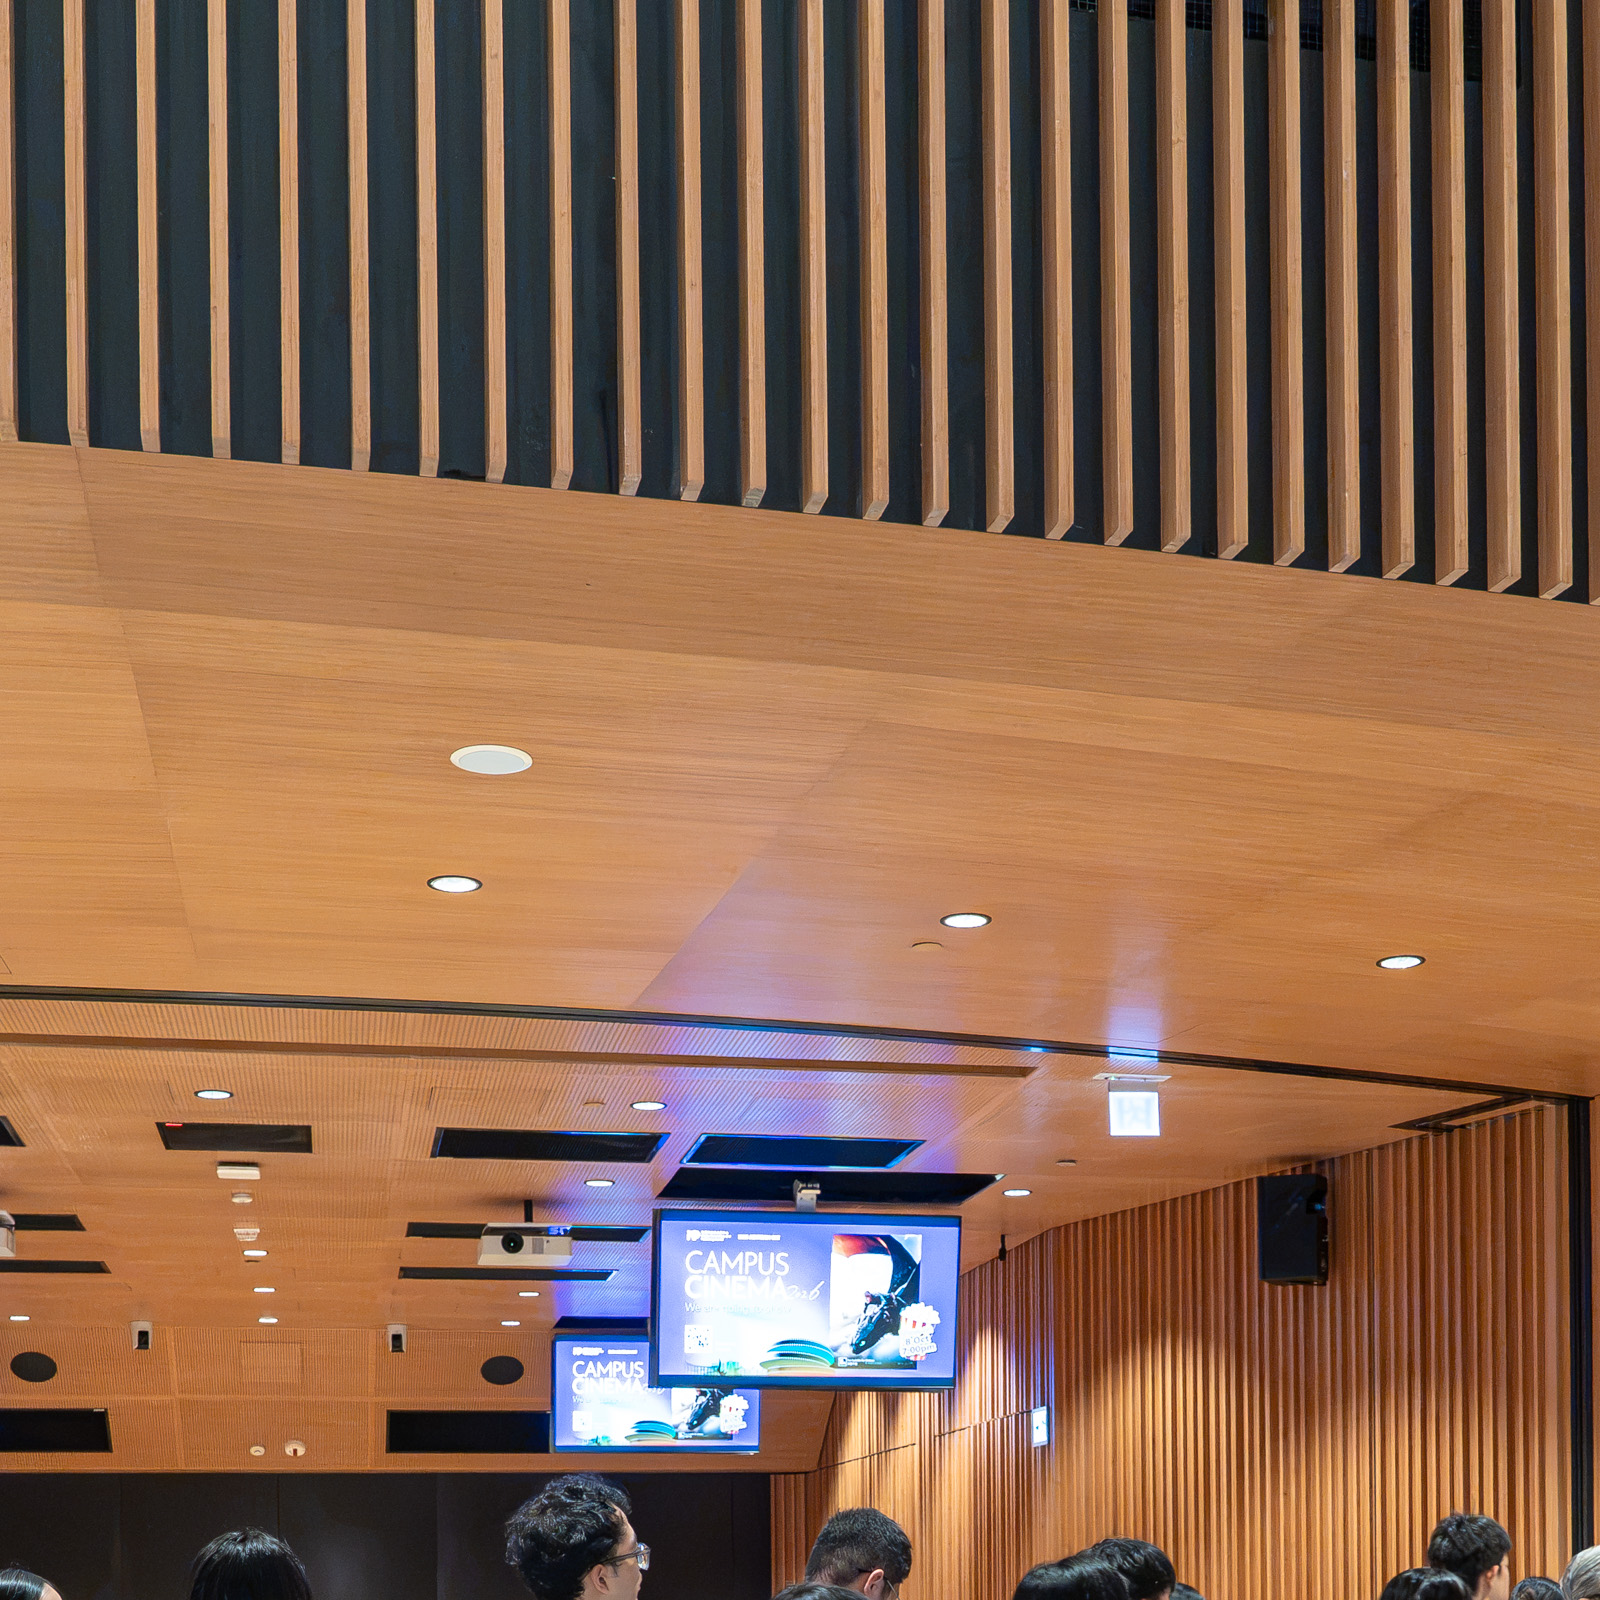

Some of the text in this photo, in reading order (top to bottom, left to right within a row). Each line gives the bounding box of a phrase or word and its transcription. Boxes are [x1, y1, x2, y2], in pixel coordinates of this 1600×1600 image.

[685, 1249, 790, 1276] CAMPUS
[684, 1275, 788, 1300] CINEMA
[571, 1360, 645, 1379] CAMPUS
